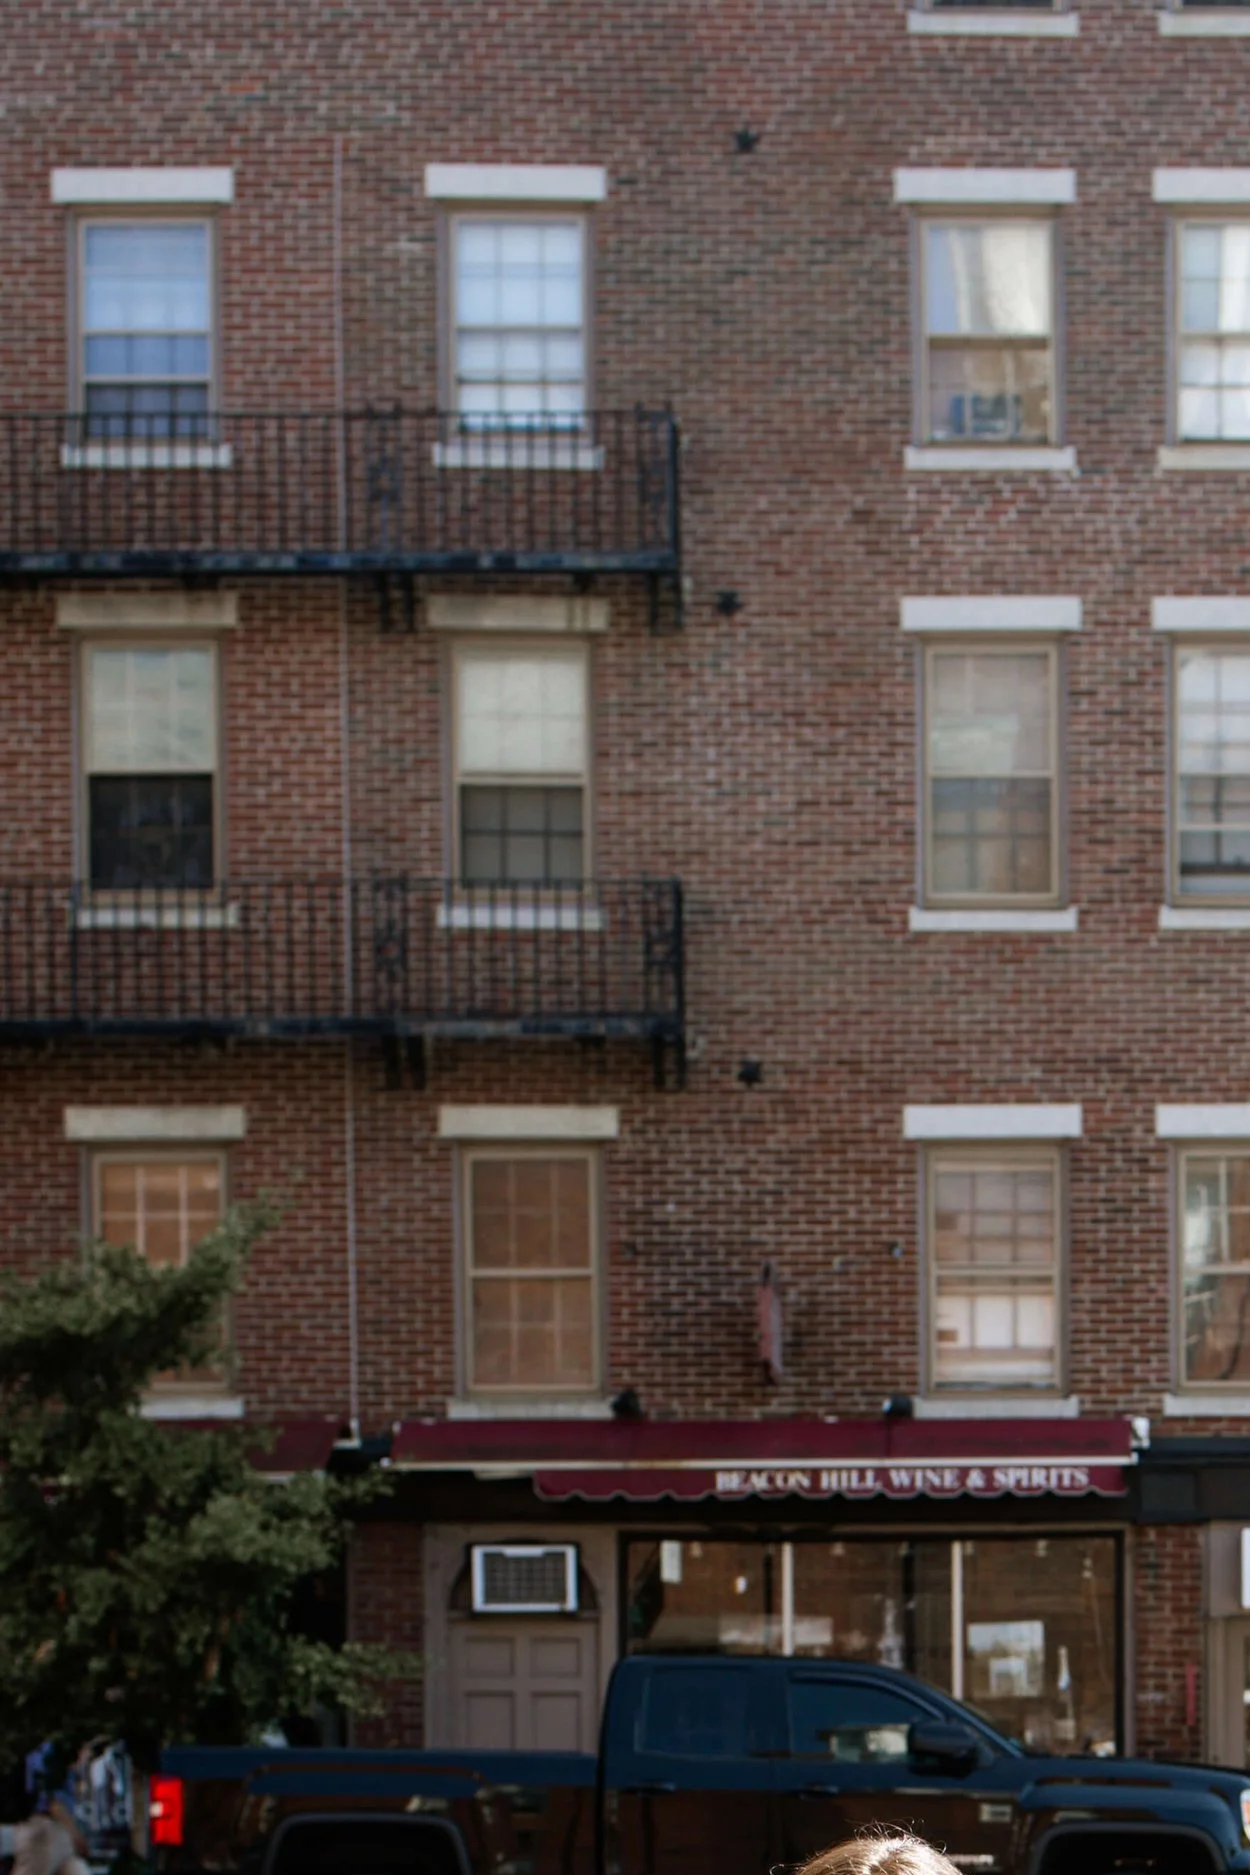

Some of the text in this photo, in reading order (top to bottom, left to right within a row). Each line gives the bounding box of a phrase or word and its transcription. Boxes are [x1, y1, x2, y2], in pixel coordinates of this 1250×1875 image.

[715, 1467, 1089, 1491] BEACON HILL WINE & SPIRITS
